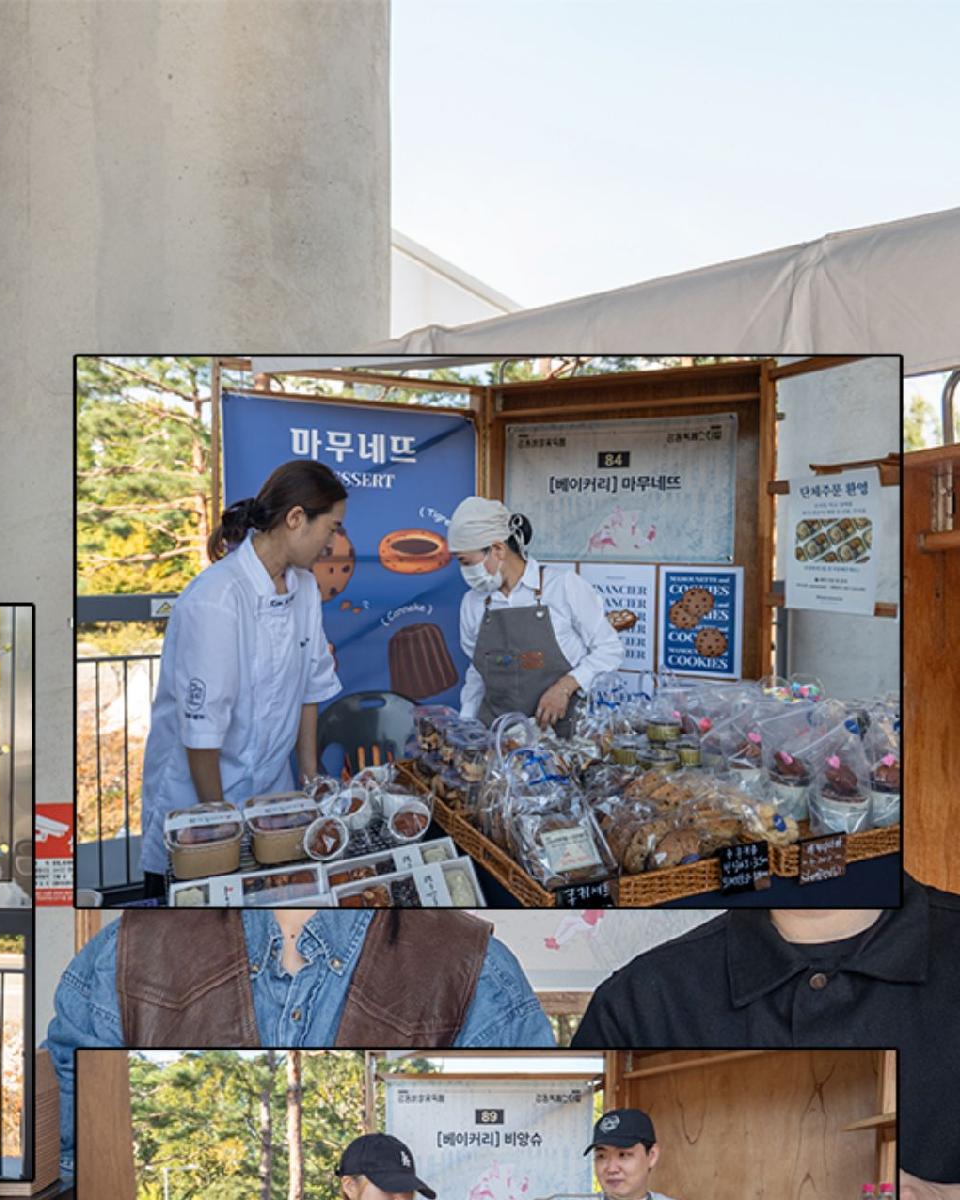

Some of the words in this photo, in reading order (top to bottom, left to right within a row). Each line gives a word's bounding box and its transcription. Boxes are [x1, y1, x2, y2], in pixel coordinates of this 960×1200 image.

[289, 427, 417, 464] 마무네뜨
[604, 453, 623, 466] 84
[335, 472, 395, 489] SSERT
[549, 475, 618, 494] [베이커리]
[621, 475, 682, 492] 마무네뜨
[593, 585, 647, 595] NANCIER
[669, 584, 730, 596] COIES
[668, 654, 728, 669] COOKIES
[480, 1111, 498, 1122] 89
[437, 1131, 500, 1148] [베이커리]
[504, 1132, 543, 1147] 비앙슈
